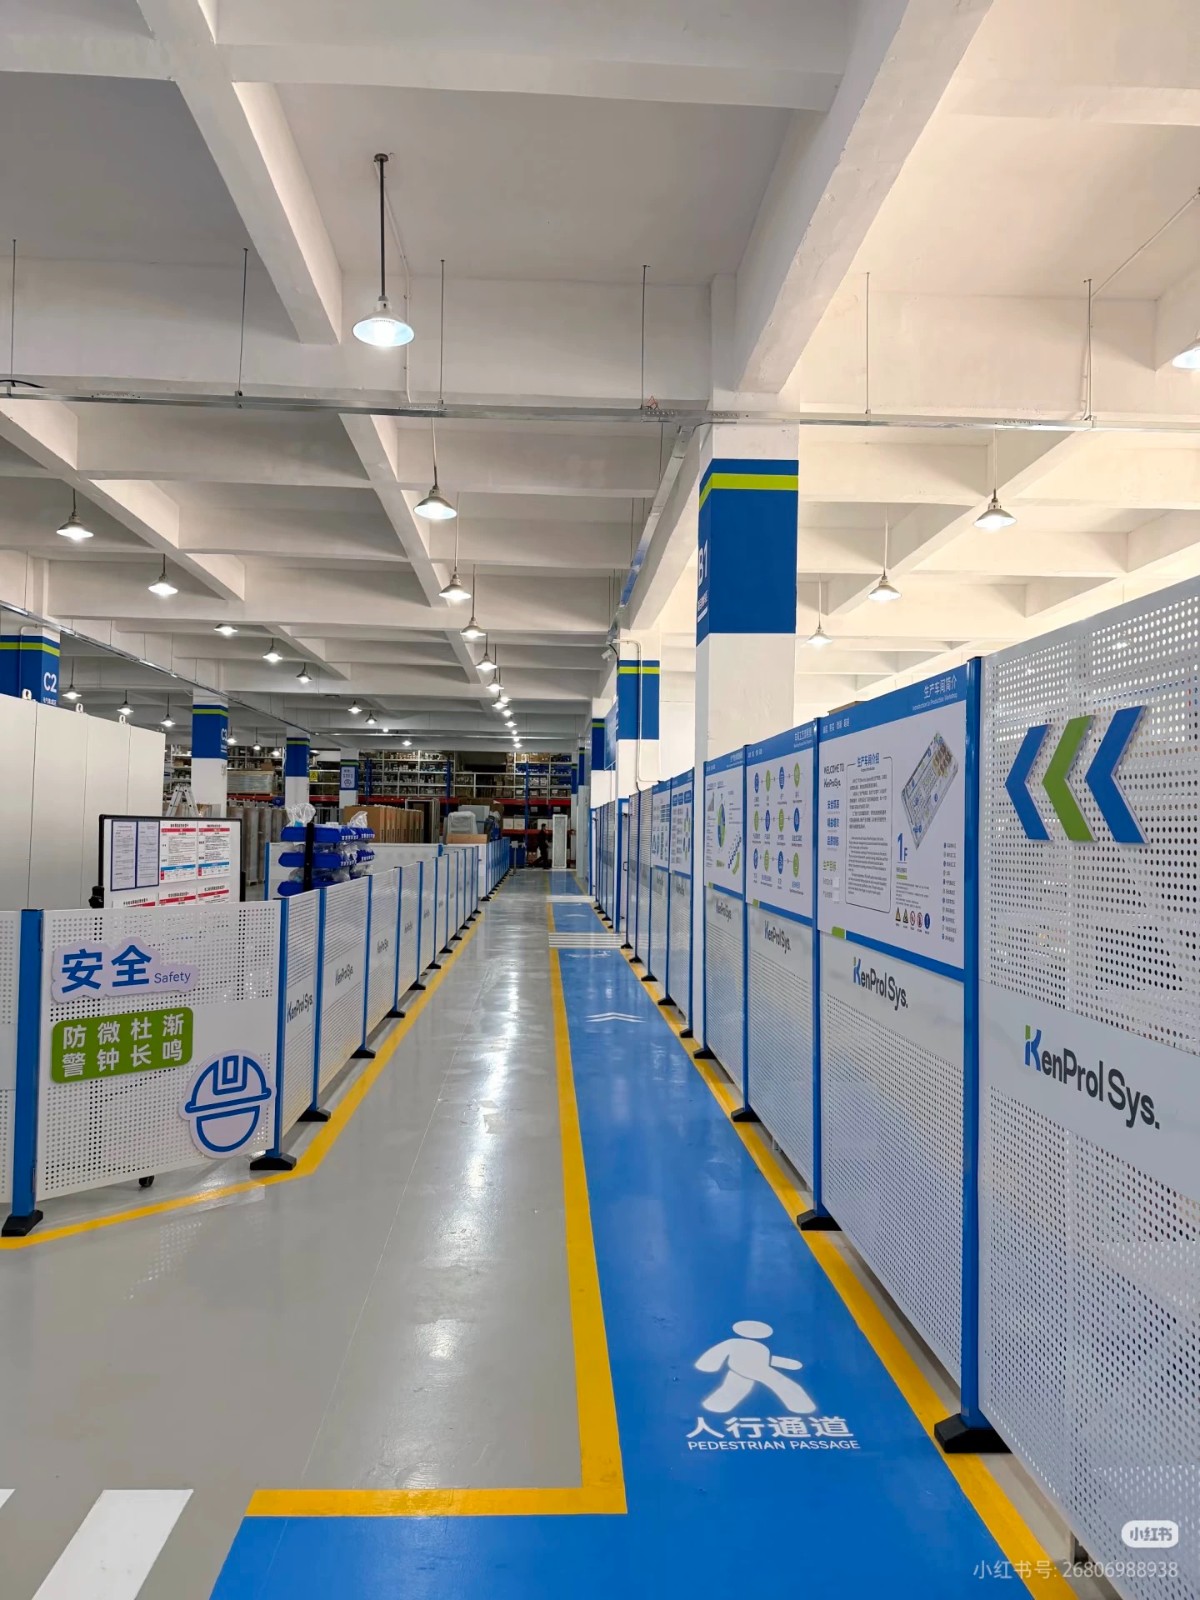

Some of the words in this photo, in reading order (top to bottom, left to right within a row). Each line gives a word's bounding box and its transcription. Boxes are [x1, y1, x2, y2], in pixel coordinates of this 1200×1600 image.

[698, 540, 708, 586] B1
[44, 672, 57, 693] C2
[924, 674, 957, 699] 生产车间简介
[897, 833, 908, 861] 1F
[62, 945, 152, 993] 安全
[154, 972, 191, 984] Safety
[63, 1013, 184, 1050] 防微杜渐
[62, 1039, 183, 1078] 警钟长鸣
[686, 1417, 853, 1439] 人行通道
[687, 1440, 785, 1450] PEDESTRIAN
[790, 1440, 861, 1450] PASSAGE
